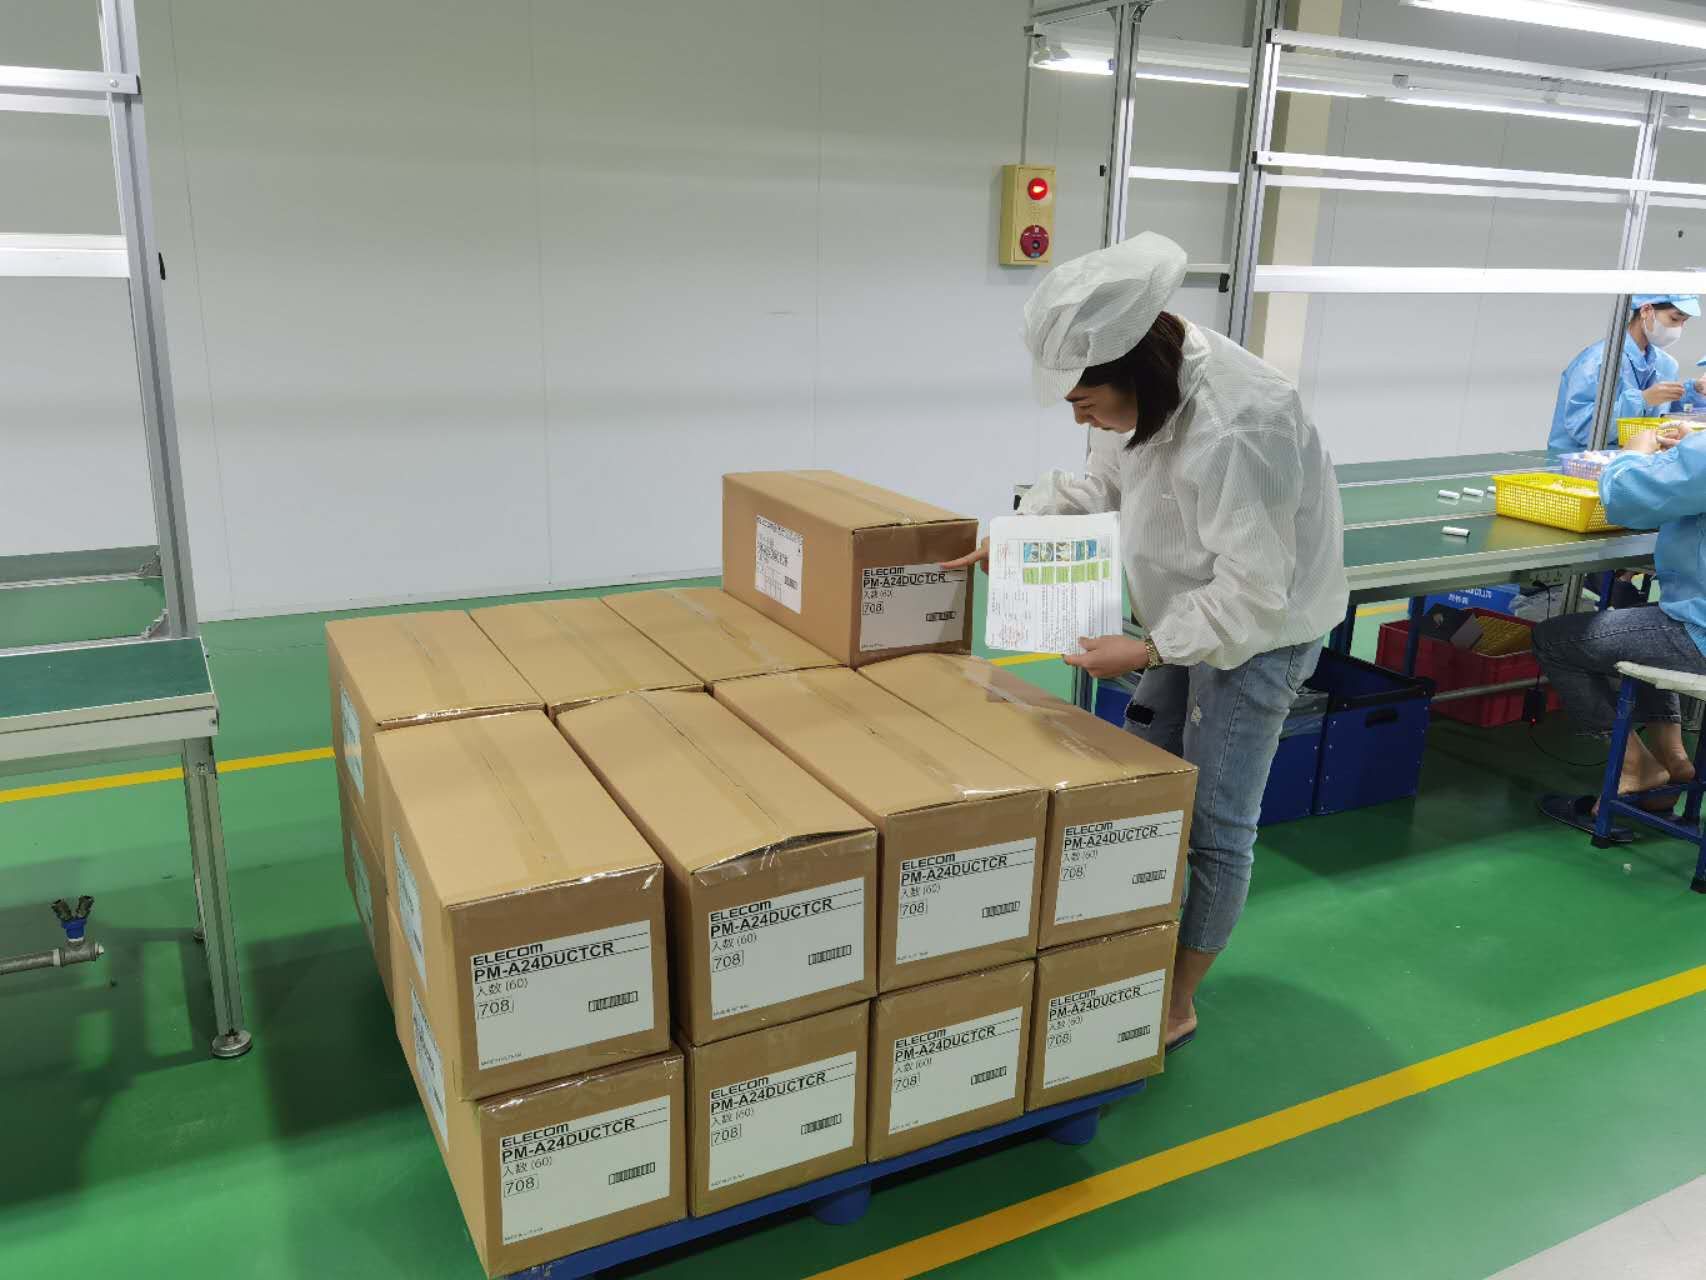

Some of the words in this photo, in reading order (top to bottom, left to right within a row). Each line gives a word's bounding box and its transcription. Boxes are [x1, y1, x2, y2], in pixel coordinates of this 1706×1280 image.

[901, 856, 1007, 886] PM-A24DUCTCR
[710, 898, 832, 937] PM-A24DUCTCR
[903, 903, 925, 916] 708
[474, 942, 614, 982] PM-A24DUCTCR
[713, 953, 741, 970] 708
[479, 999, 510, 1017] 708
[895, 1025, 996, 1062] PM-A24DUCTCR
[711, 1072, 826, 1113] PM-A24DUCTCR
[895, 1076, 917, 1090] 708
[502, 1118, 635, 1164] PM-A24DUCTCR
[714, 1127, 739, 1143] 708
[506, 1177, 535, 1195] 708
